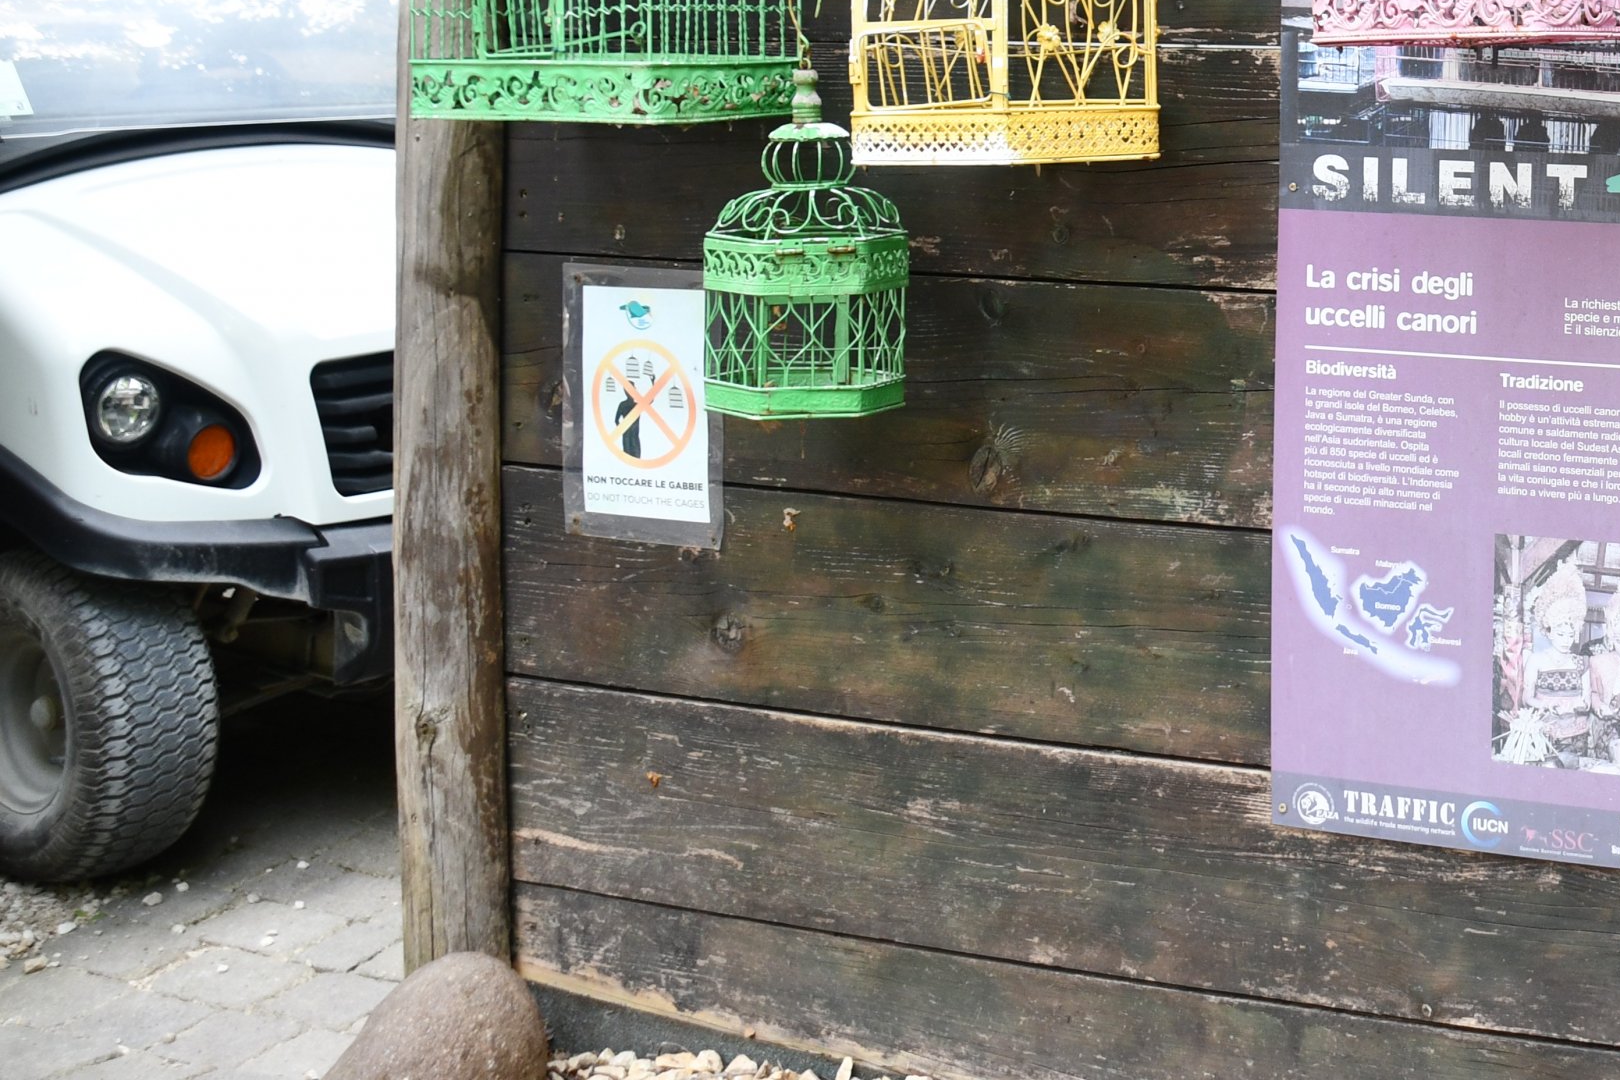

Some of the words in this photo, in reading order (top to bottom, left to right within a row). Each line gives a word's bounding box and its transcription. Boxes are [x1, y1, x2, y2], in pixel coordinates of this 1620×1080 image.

[1312, 154, 1588, 211] SILENT
[1306, 264, 1334, 289] La
[1346, 268, 1400, 293] crisi
[1411, 271, 1473, 300] degli
[1564, 297, 1578, 309] La
[1305, 305, 1385, 329] uccelli
[1396, 310, 1476, 335] canori
[1564, 312, 1600, 325] specie
[1603, 315, 1610, 324] e
[1564, 323, 1572, 335] E
[1575, 324, 1581, 336] il
[1305, 360, 1397, 380] Biodiversità
[1500, 373, 1584, 392] Tradizione
[1305, 386, 1317, 396] La
[1318, 387, 1351, 400] regione
[1353, 389, 1367, 399] del
[1369, 390, 1403, 401] Greater
[1404, 392, 1436, 405] Sunda,
[1305, 398, 1314, 408] le
[1315, 400, 1343, 410] grandi
[1344, 401, 1365, 411] isole
[1366, 402, 1380, 412] del
[1419, 406, 1458, 419] Celebes,
[1499, 400, 1505, 409] Il
[1507, 402, 1550, 413] possesso
[1552, 403, 1561, 413] di
[1563, 405, 1592, 415] uccelli
[1305, 410, 1326, 421] Java
[1404, 416, 1438, 430] regione
[1499, 413, 1527, 425] hobby
[1529, 414, 1536, 424] è
[1304, 422, 1372, 437] ecologicamente
[1498, 427, 1535, 436] comune
[1546, 428, 1599, 440] saldamente
[586, 475, 607, 485] NON
[610, 477, 653, 488] TOCCARE
[655, 480, 666, 489] LE
[668, 480, 703, 491] GABBIE
[587, 492, 601, 502] DO
[603, 493, 621, 503] NOT
[623, 495, 652, 505] TOUCH
[654, 497, 672, 507] THE
[674, 498, 705, 509] CAGES
[1330, 545, 1360, 555] Sumatra
[1375, 601, 1401, 611] Borneo
[1343, 790, 1455, 825] TRAFFIC
[1473, 817, 1508, 834] IUCN
[1552, 829, 1594, 852] SSC
